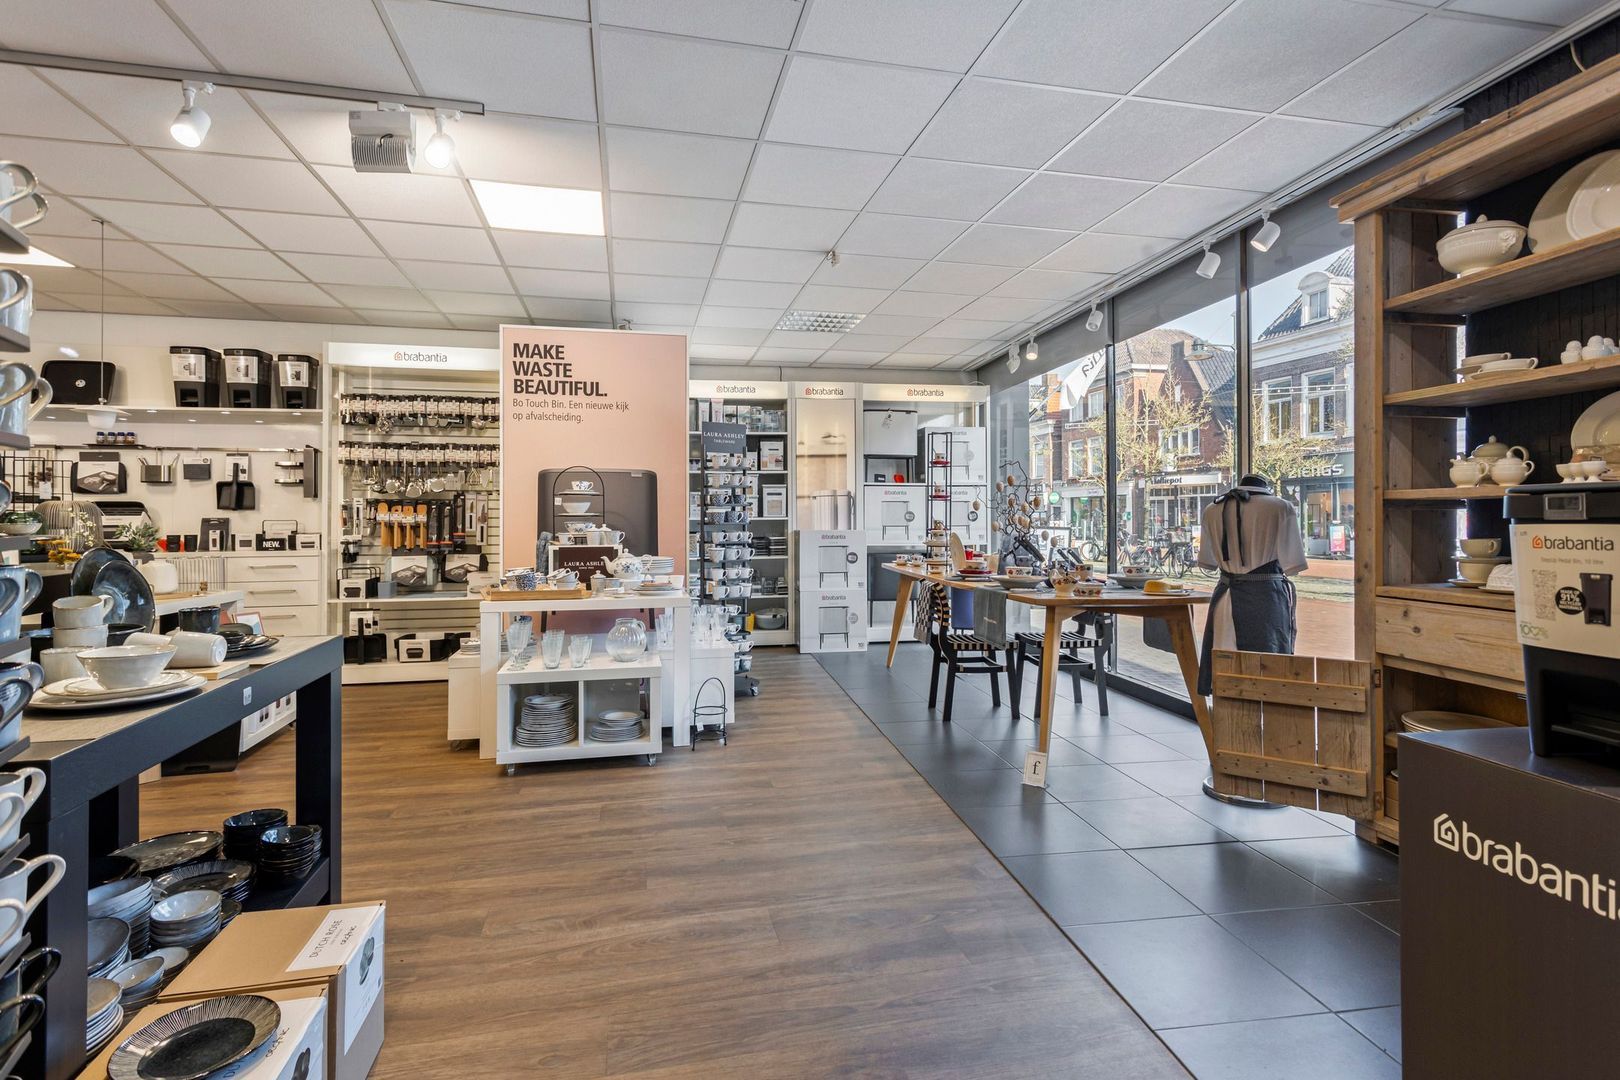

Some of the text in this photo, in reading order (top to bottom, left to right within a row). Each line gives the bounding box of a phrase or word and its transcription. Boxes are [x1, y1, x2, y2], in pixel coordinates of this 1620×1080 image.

[404, 352, 448, 362] brabantia
[513, 343, 565, 360] MAKE
[512, 361, 572, 378] WASTE
[514, 379, 608, 396] BEAUTIFUL.
[722, 386, 756, 394] brabantia
[812, 388, 844, 396] brabantia
[913, 388, 944, 396] brabantia
[512, 399, 629, 412] Bo Touch Bin. Een nieuwe kijk
[512, 411, 584, 424] op afvalscheiding.
[1544, 536, 1614, 551] brabantia
[1560, 593, 1580, 602] 91%
[1462, 820, 1620, 923] brabanti
[309, 933, 330, 958] DUTCH
